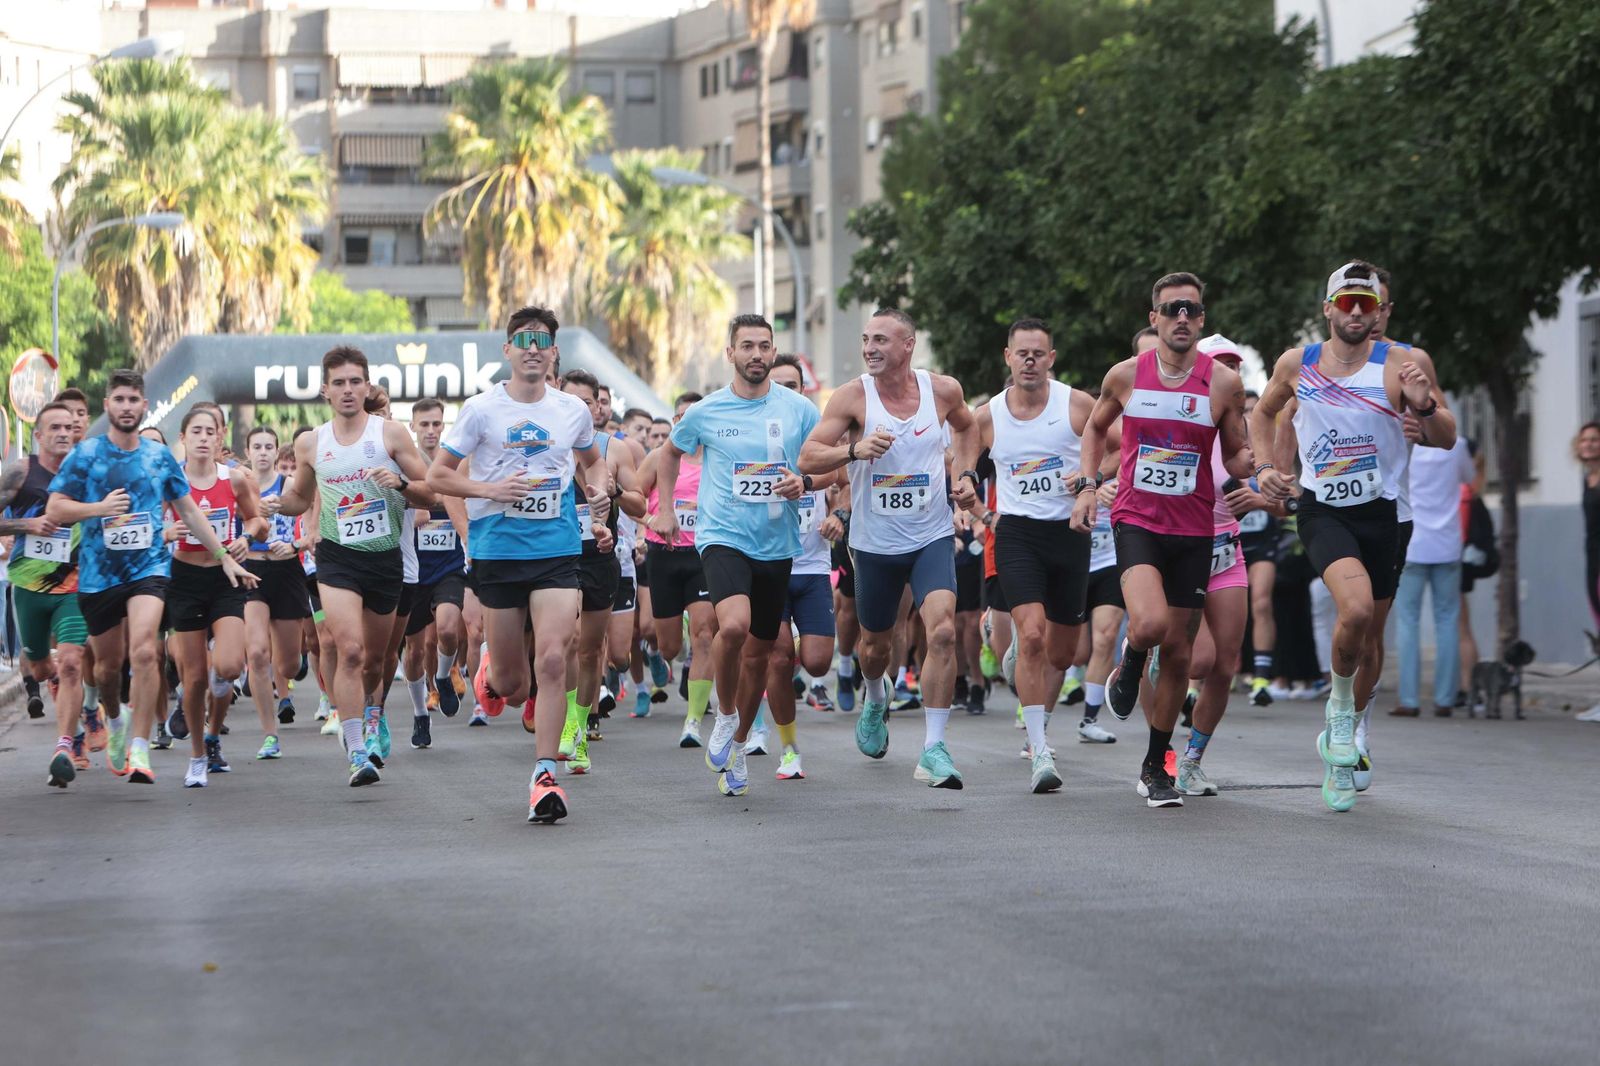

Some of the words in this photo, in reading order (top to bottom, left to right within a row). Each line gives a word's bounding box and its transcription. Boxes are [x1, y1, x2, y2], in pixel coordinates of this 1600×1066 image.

[255, 343, 502, 399] runink
[521, 430, 539, 441] 5K
[1141, 467, 1178, 488] 233
[739, 481, 772, 496] 223
[1018, 476, 1052, 495] 240
[1323, 479, 1363, 501] 290
[512, 497, 547, 512] 426
[879, 492, 913, 508] 188
[345, 518, 375, 537] 278
[110, 530, 140, 545] 262
[423, 534, 447, 546] 362
[34, 540, 53, 555] 30
